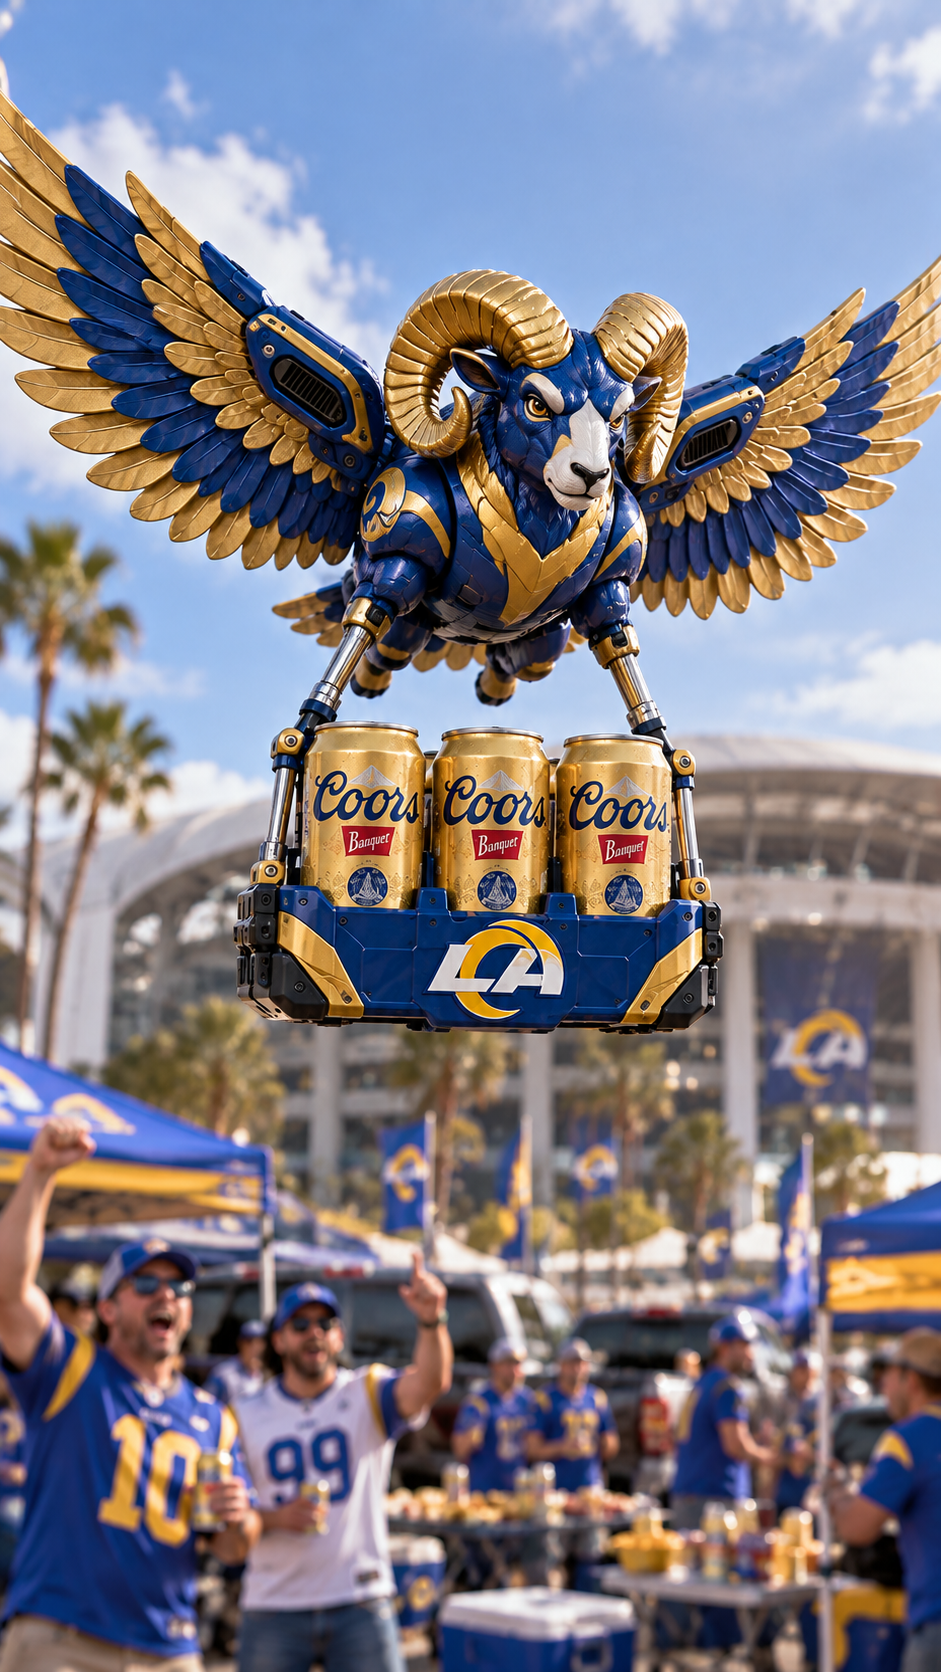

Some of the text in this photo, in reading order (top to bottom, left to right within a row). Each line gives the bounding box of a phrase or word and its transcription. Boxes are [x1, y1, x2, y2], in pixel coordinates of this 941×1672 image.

[313, 770, 420, 824] Coors
[443, 775, 546, 828] Coors
[568, 780, 667, 832] Coors
[348, 831, 391, 853] Banquet
[477, 834, 519, 857] Banquet
[604, 839, 645, 862] Banquet
[427, 943, 564, 995] LA
[772, 1028, 867, 1069] LA
[98, 1413, 200, 1547] 10
[267, 1425, 352, 1506] 99
